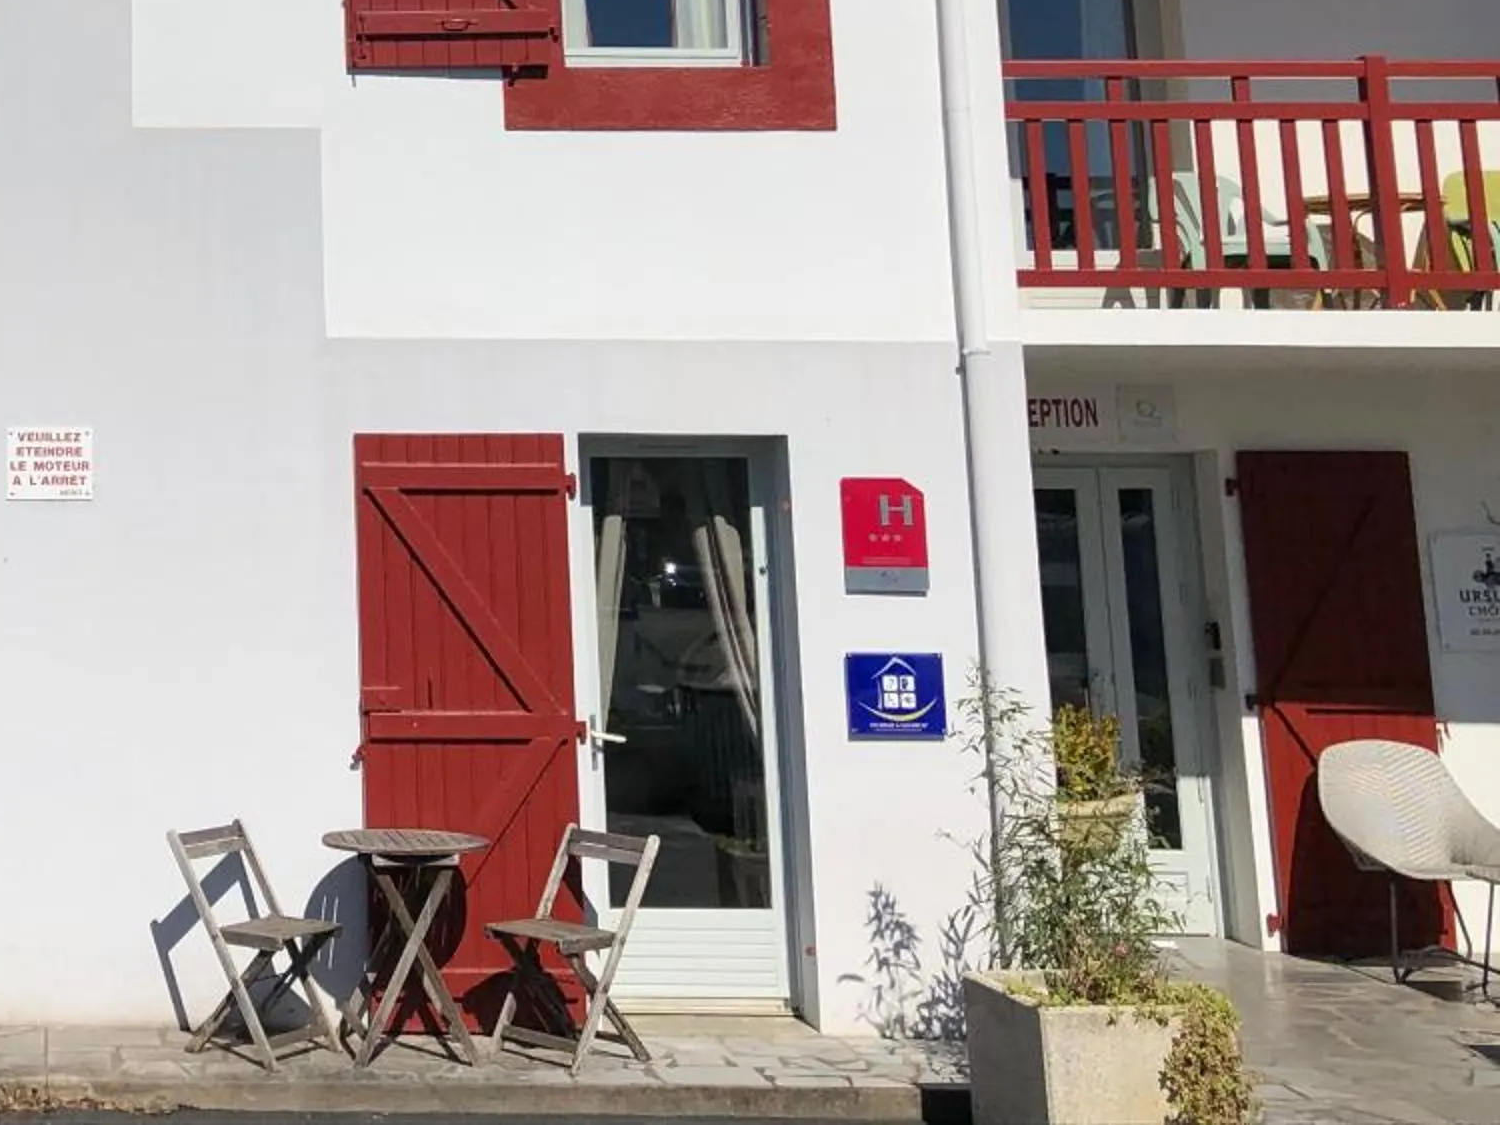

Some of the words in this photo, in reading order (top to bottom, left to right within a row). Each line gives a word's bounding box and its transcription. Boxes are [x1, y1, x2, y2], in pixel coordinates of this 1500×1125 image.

[17, 431, 82, 442] VEUILLEZ
[16, 446, 83, 457] ETEINDRE
[9, 460, 27, 472] LE
[33, 460, 90, 472] MOTEUR
[878, 494, 915, 527] H
